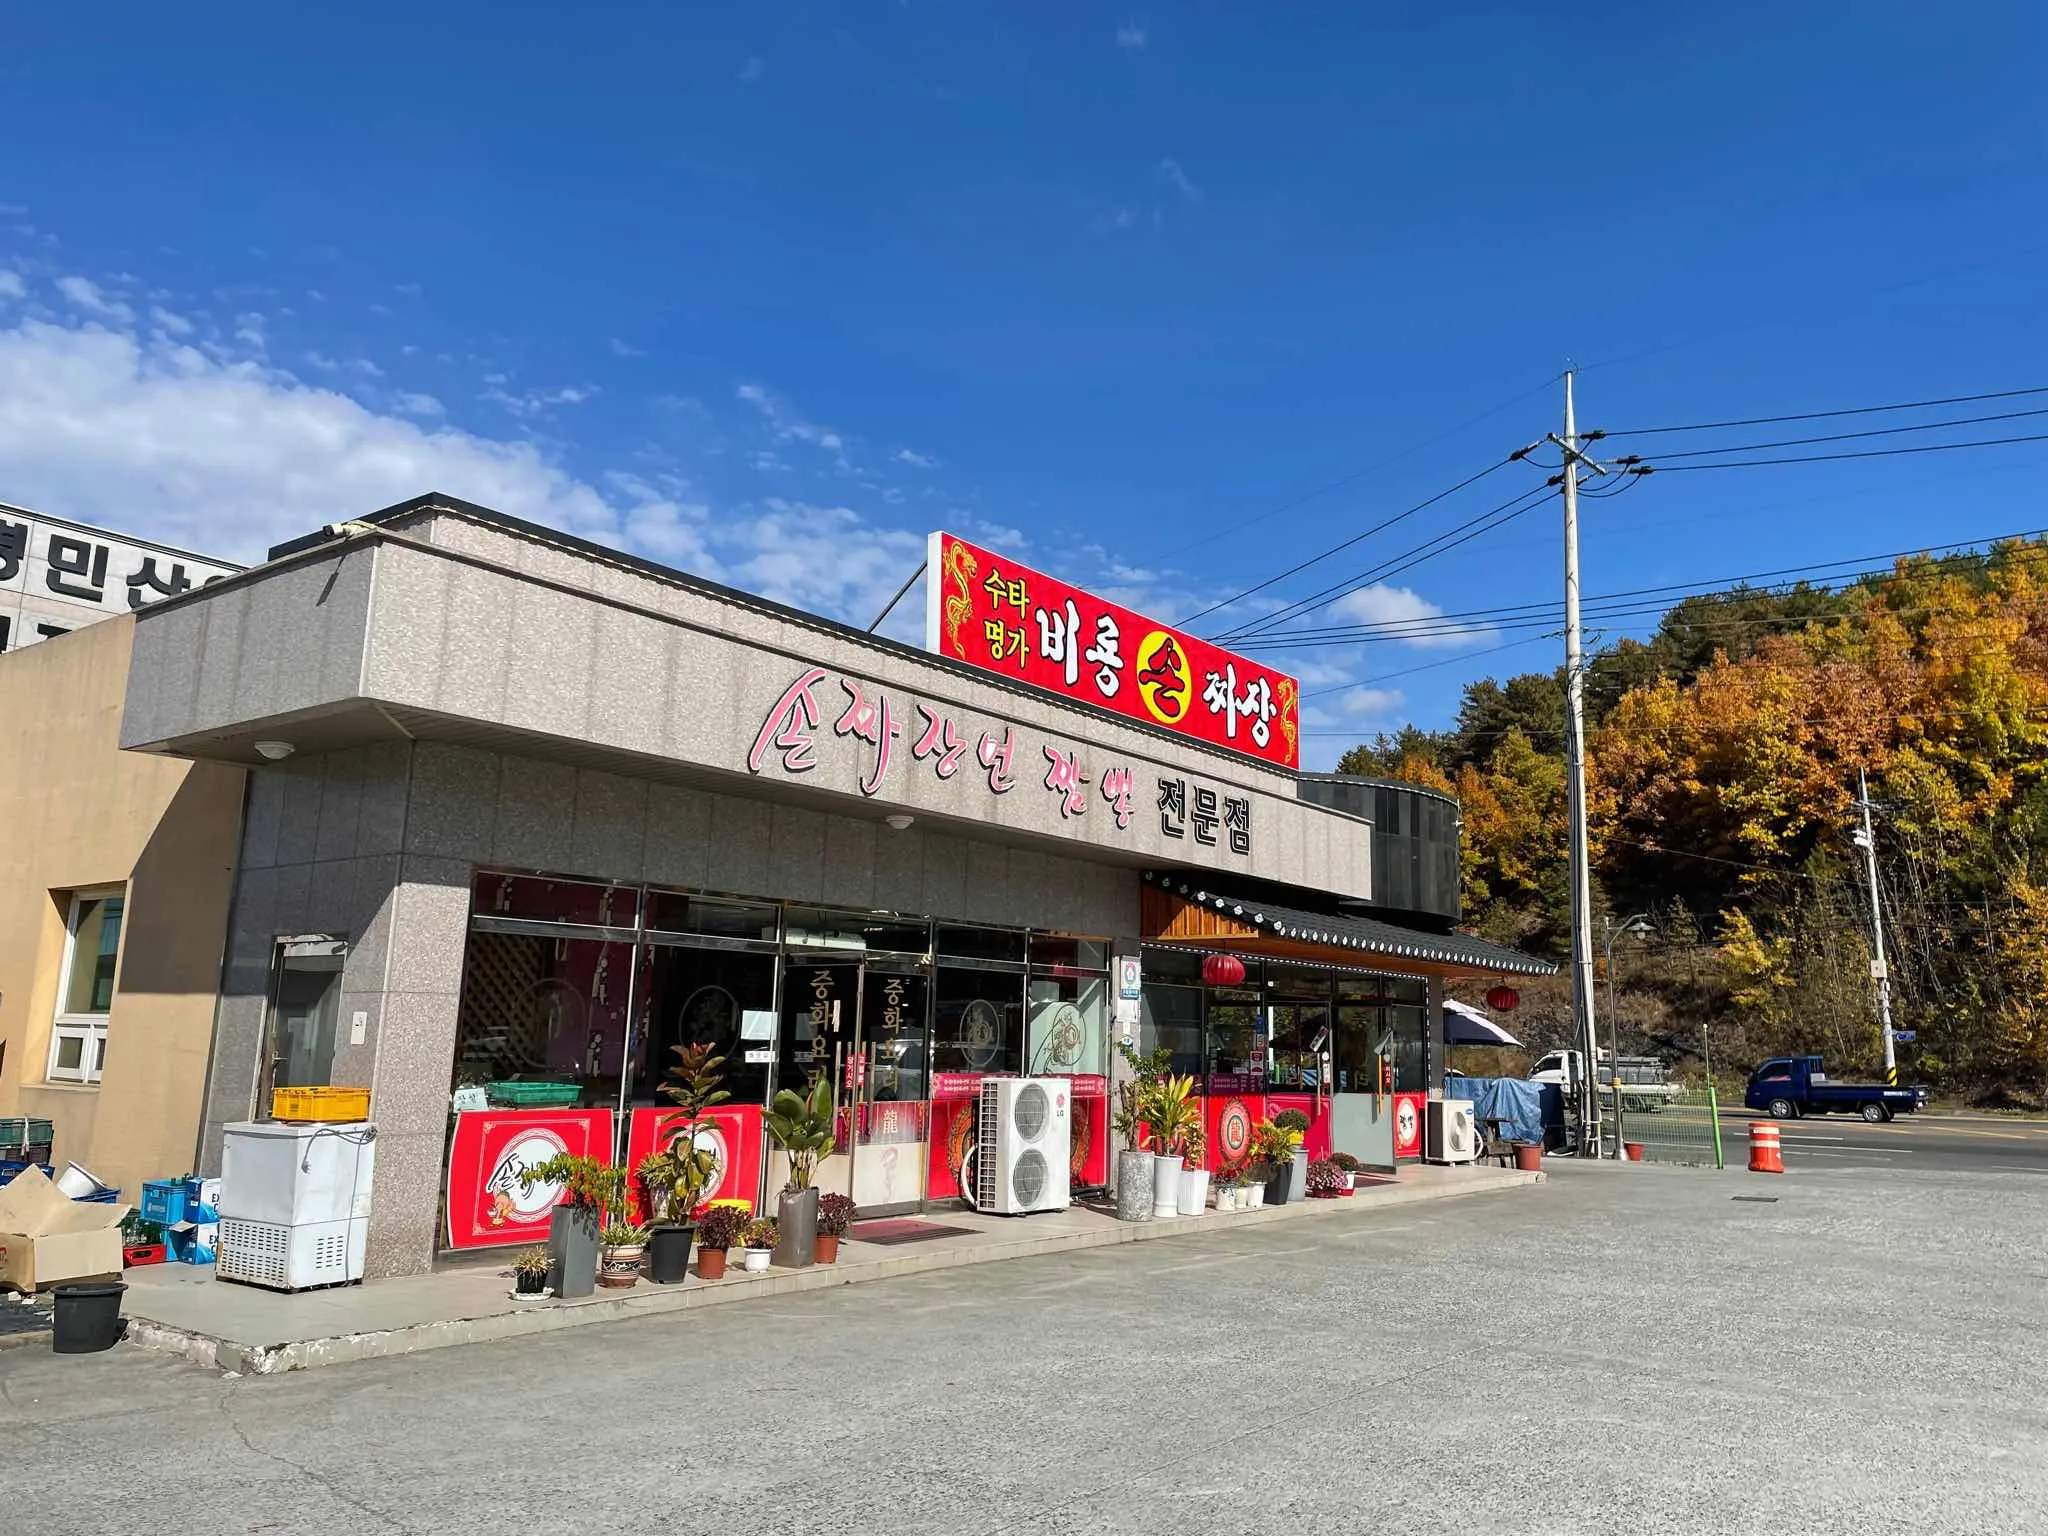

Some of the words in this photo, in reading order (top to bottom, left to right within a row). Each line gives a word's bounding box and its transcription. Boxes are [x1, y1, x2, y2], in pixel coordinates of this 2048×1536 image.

[983, 568, 1030, 620] 수타
[983, 619, 1030, 669] 명가
[1138, 636, 1185, 717] 손
[1201, 661, 1277, 749] 짜장
[1042, 744, 1136, 831] 짬뽕
[1157, 776, 1251, 856] 전문점
